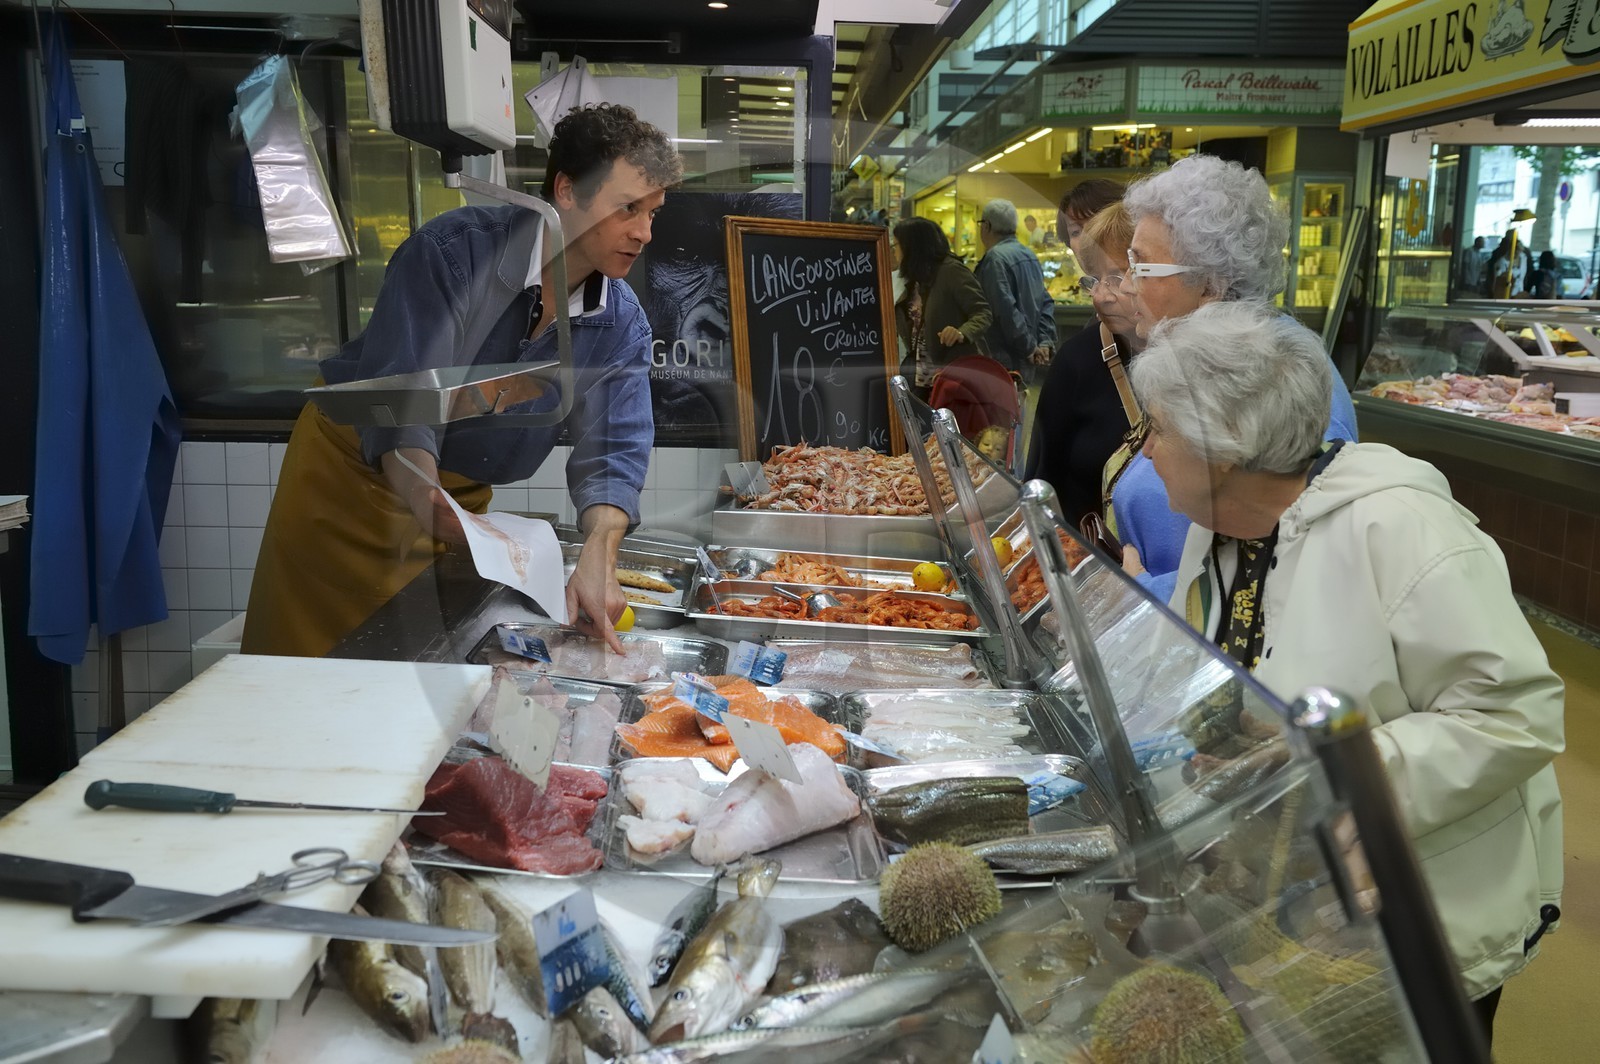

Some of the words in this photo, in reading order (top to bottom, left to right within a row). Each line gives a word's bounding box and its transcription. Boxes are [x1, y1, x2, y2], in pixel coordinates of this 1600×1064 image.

[1351, 2, 1477, 101] VOLAILLES
[1181, 68, 1235, 89] Pascal
[751, 250, 873, 304] LANGOUSTINES
[650, 367, 690, 379] MUSÉUM
[693, 370, 706, 379] DE
[824, 357, 848, 387] €
